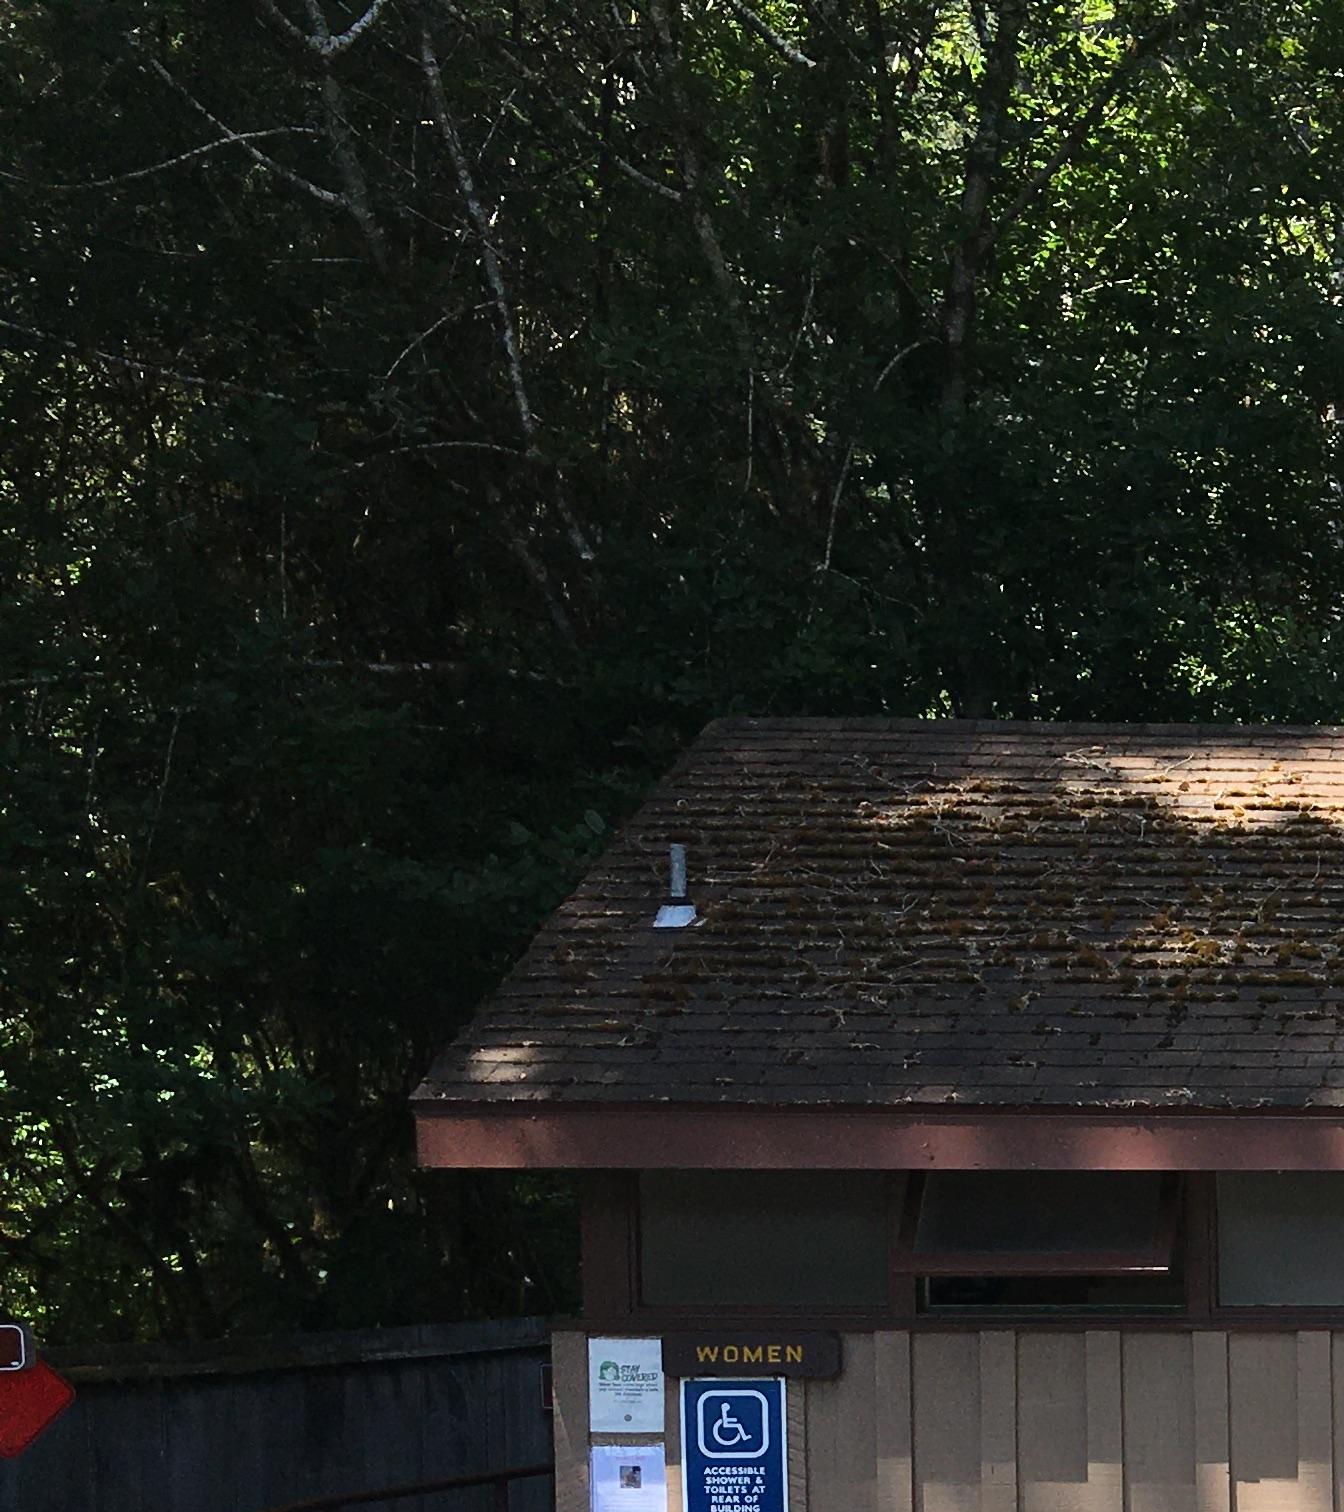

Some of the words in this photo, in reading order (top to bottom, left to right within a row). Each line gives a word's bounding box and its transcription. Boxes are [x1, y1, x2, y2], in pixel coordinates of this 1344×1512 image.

[696, 1345, 803, 1362] WOMEN
[620, 1364, 641, 1374] STAY
[621, 1373, 658, 1382] COVERED
[703, 1467, 766, 1475] ACCESSIBLE
[705, 1476, 751, 1485] SHOWER
[755, 1476, 763, 1485] &
[703, 1486, 747, 1494] TOILETS
[751, 1486, 766, 1494] AT
[711, 1495, 740, 1503] REAR
[744, 1495, 759, 1503] OF
[710, 1504, 761, 1512] BUILDING
